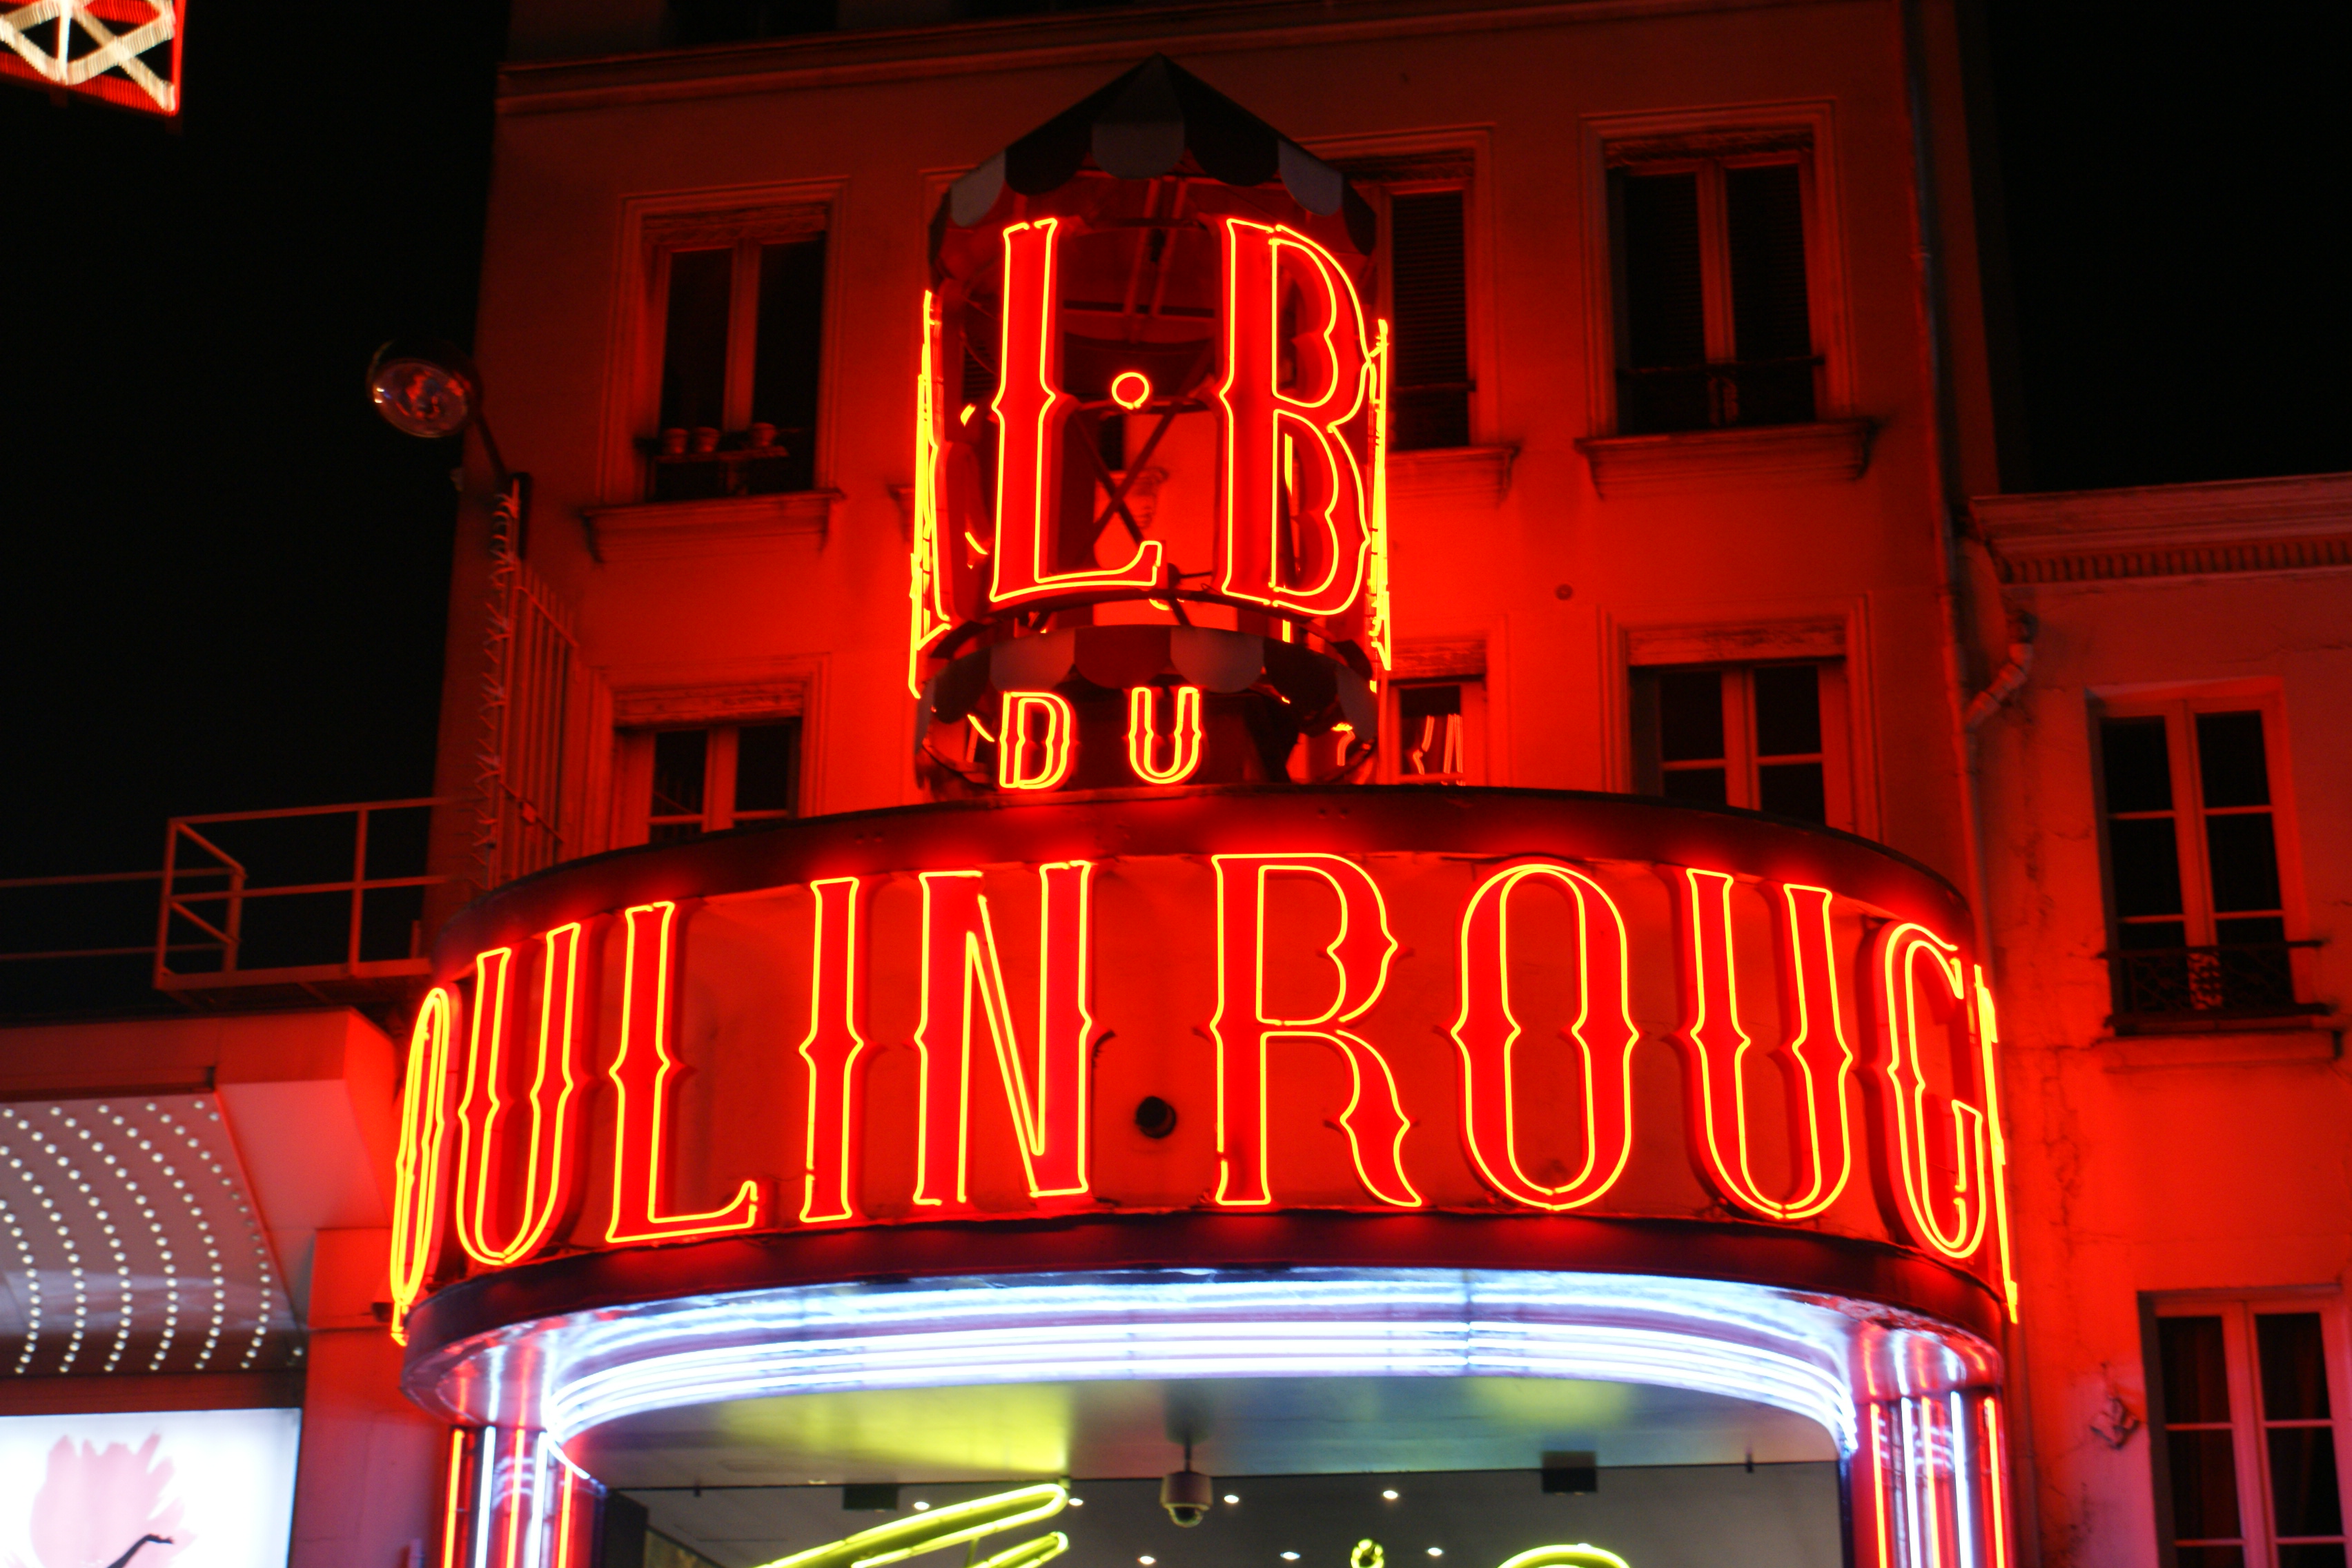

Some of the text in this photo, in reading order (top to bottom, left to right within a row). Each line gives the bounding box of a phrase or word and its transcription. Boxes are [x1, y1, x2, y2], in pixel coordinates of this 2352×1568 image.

[998, 686, 1204, 790] DU
[389, 852, 2019, 1344] OULIN ROUG
